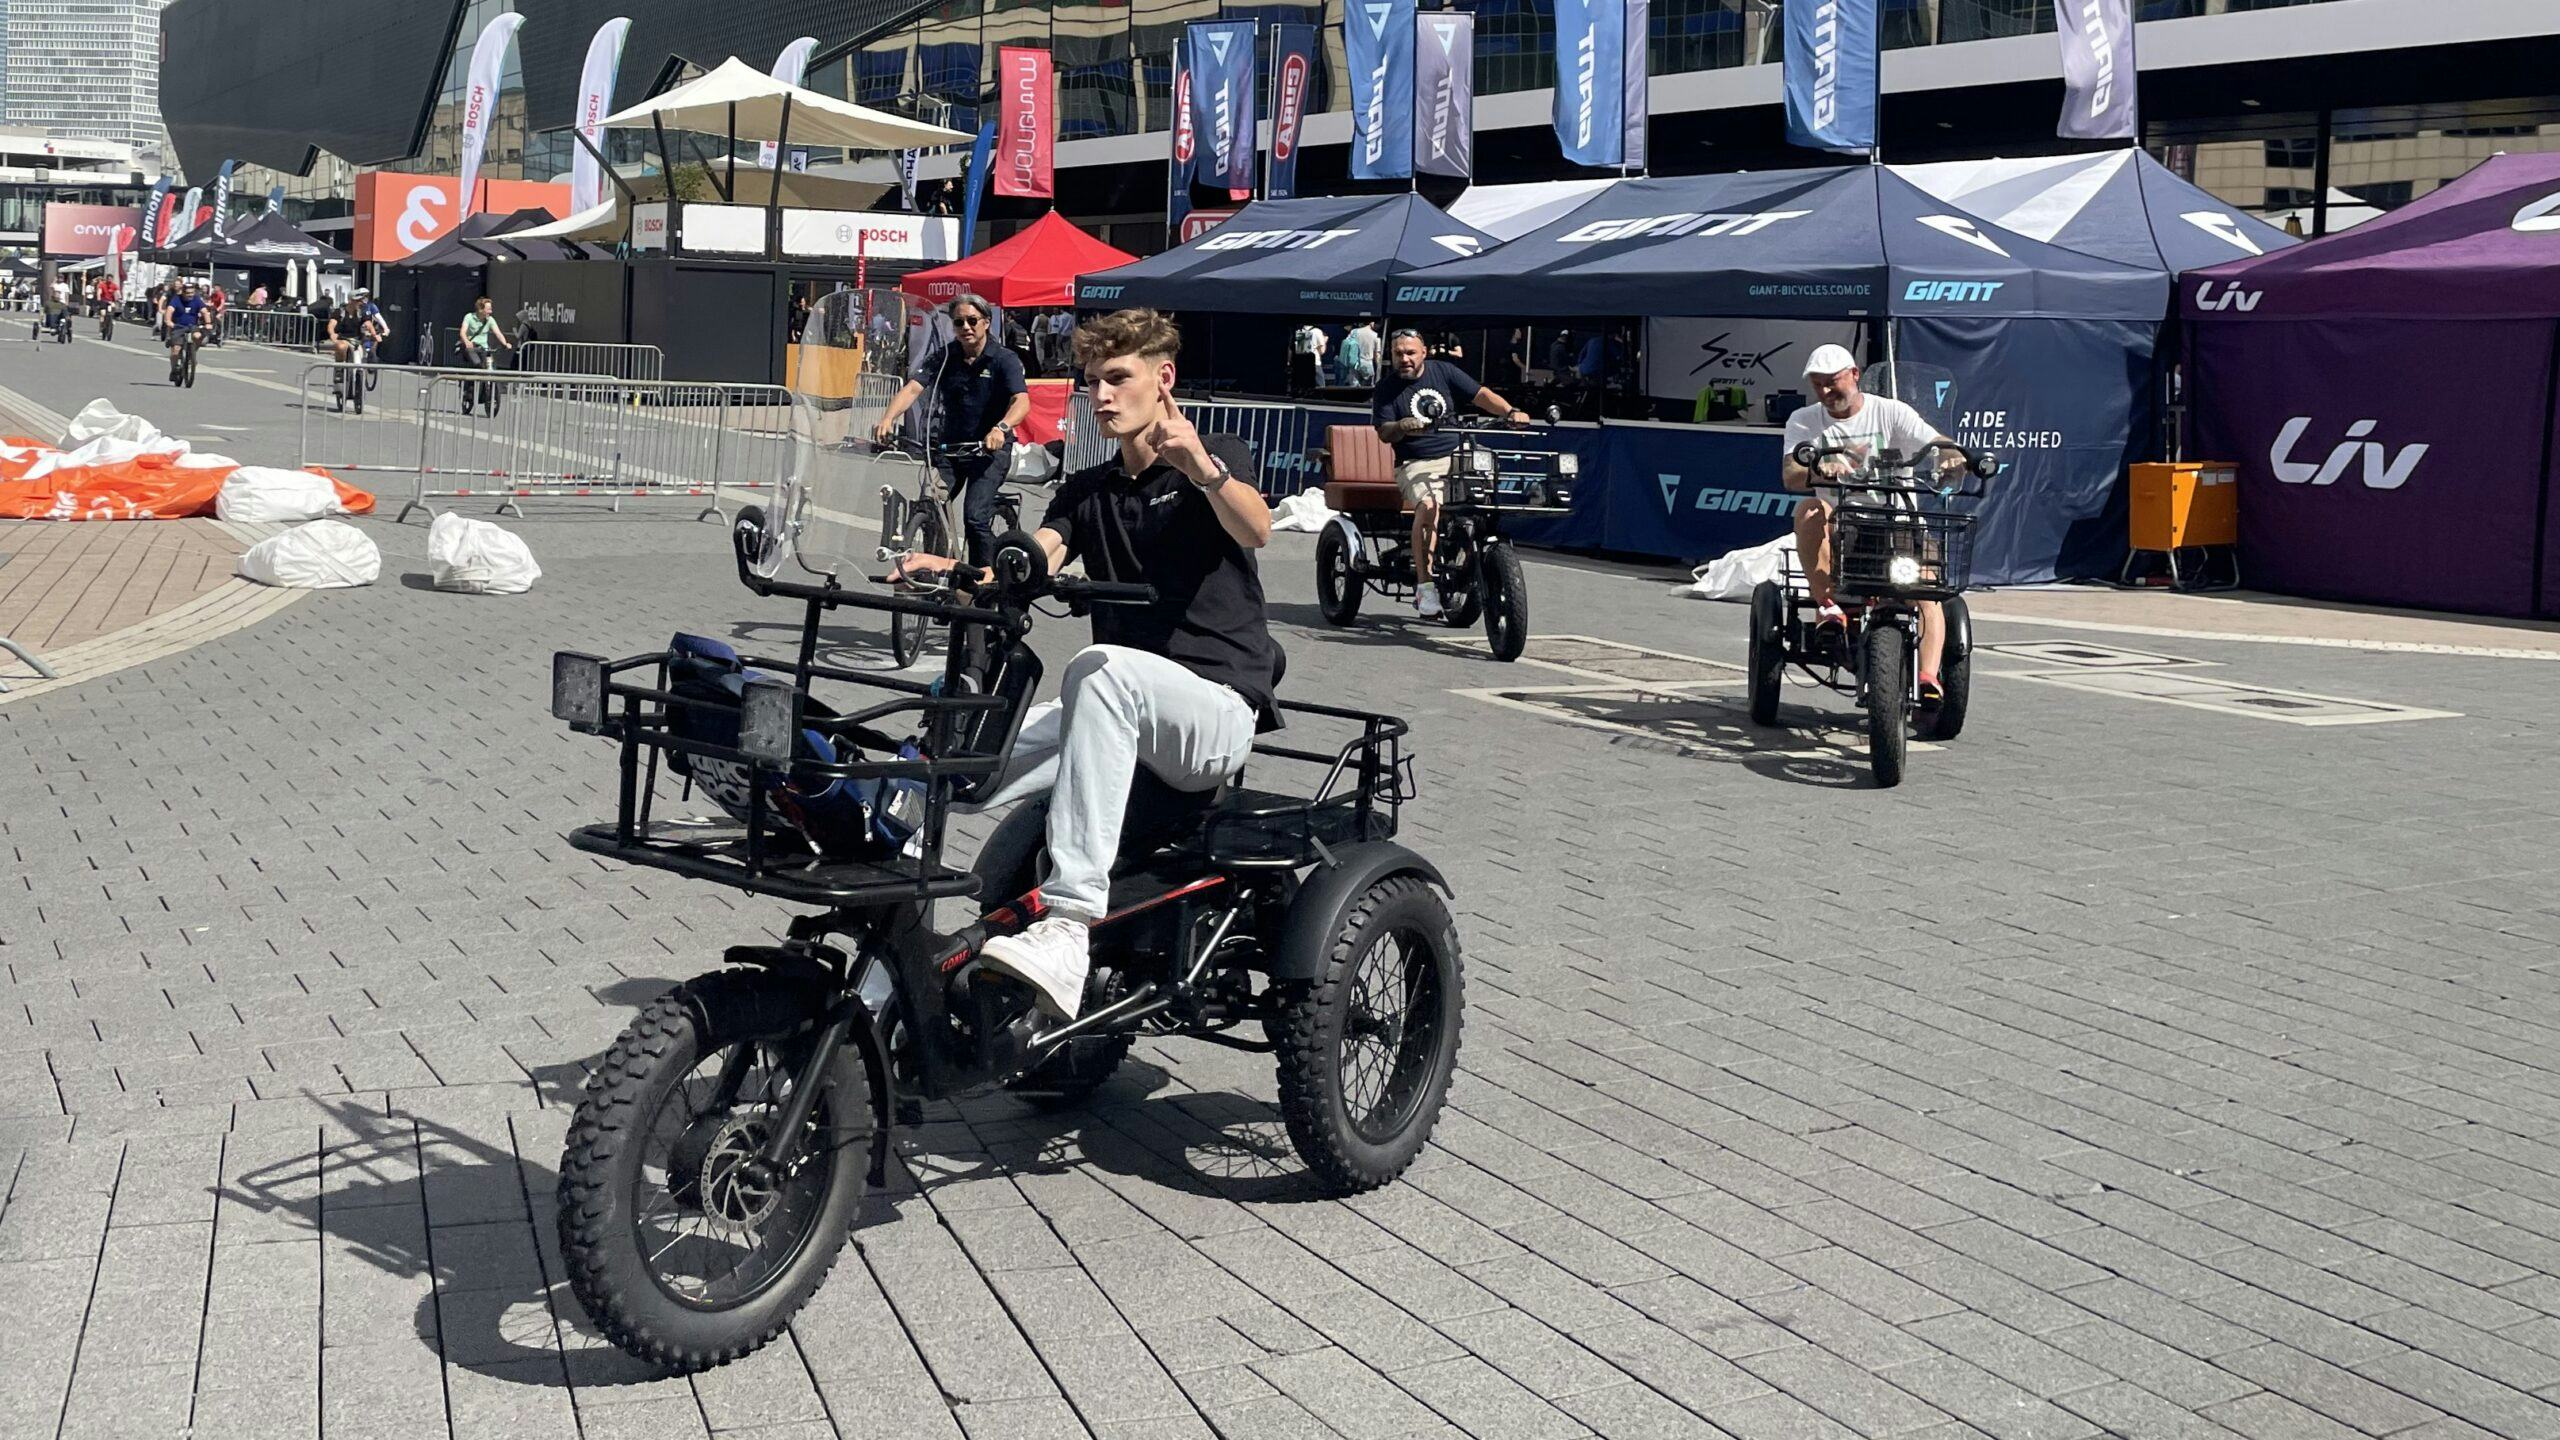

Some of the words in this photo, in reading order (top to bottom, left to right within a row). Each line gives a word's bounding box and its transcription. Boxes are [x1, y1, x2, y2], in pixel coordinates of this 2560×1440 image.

[466, 86, 485, 128] BOSCH
[587, 95, 599, 136] BOSCH
[1279, 66, 1301, 147] ABUS
[644, 219, 664, 232] BOSCH
[862, 229, 908, 243] BOSCH
[1556, 210, 1814, 243] GIANT
[1194, 229, 1361, 250] GIANT
[1081, 285, 1125, 299] GIANT
[1300, 290, 1374, 301] GIANT-BICYCLES.COM/DE
[1396, 286, 1466, 302] GIANT
[1749, 284, 1871, 296] GIANT-BICYCLES.COM/DE
[1903, 281, 2004, 302] GIANT
[2195, 281, 2263, 312] Liv
[541, 303, 554, 321] the
[556, 303, 576, 324] Flow
[1958, 411, 2006, 428] RIDE
[1956, 431, 2062, 449] UNLEASHED
[1266, 451, 1322, 473] GIAN
[2270, 416, 2429, 489] Liv
